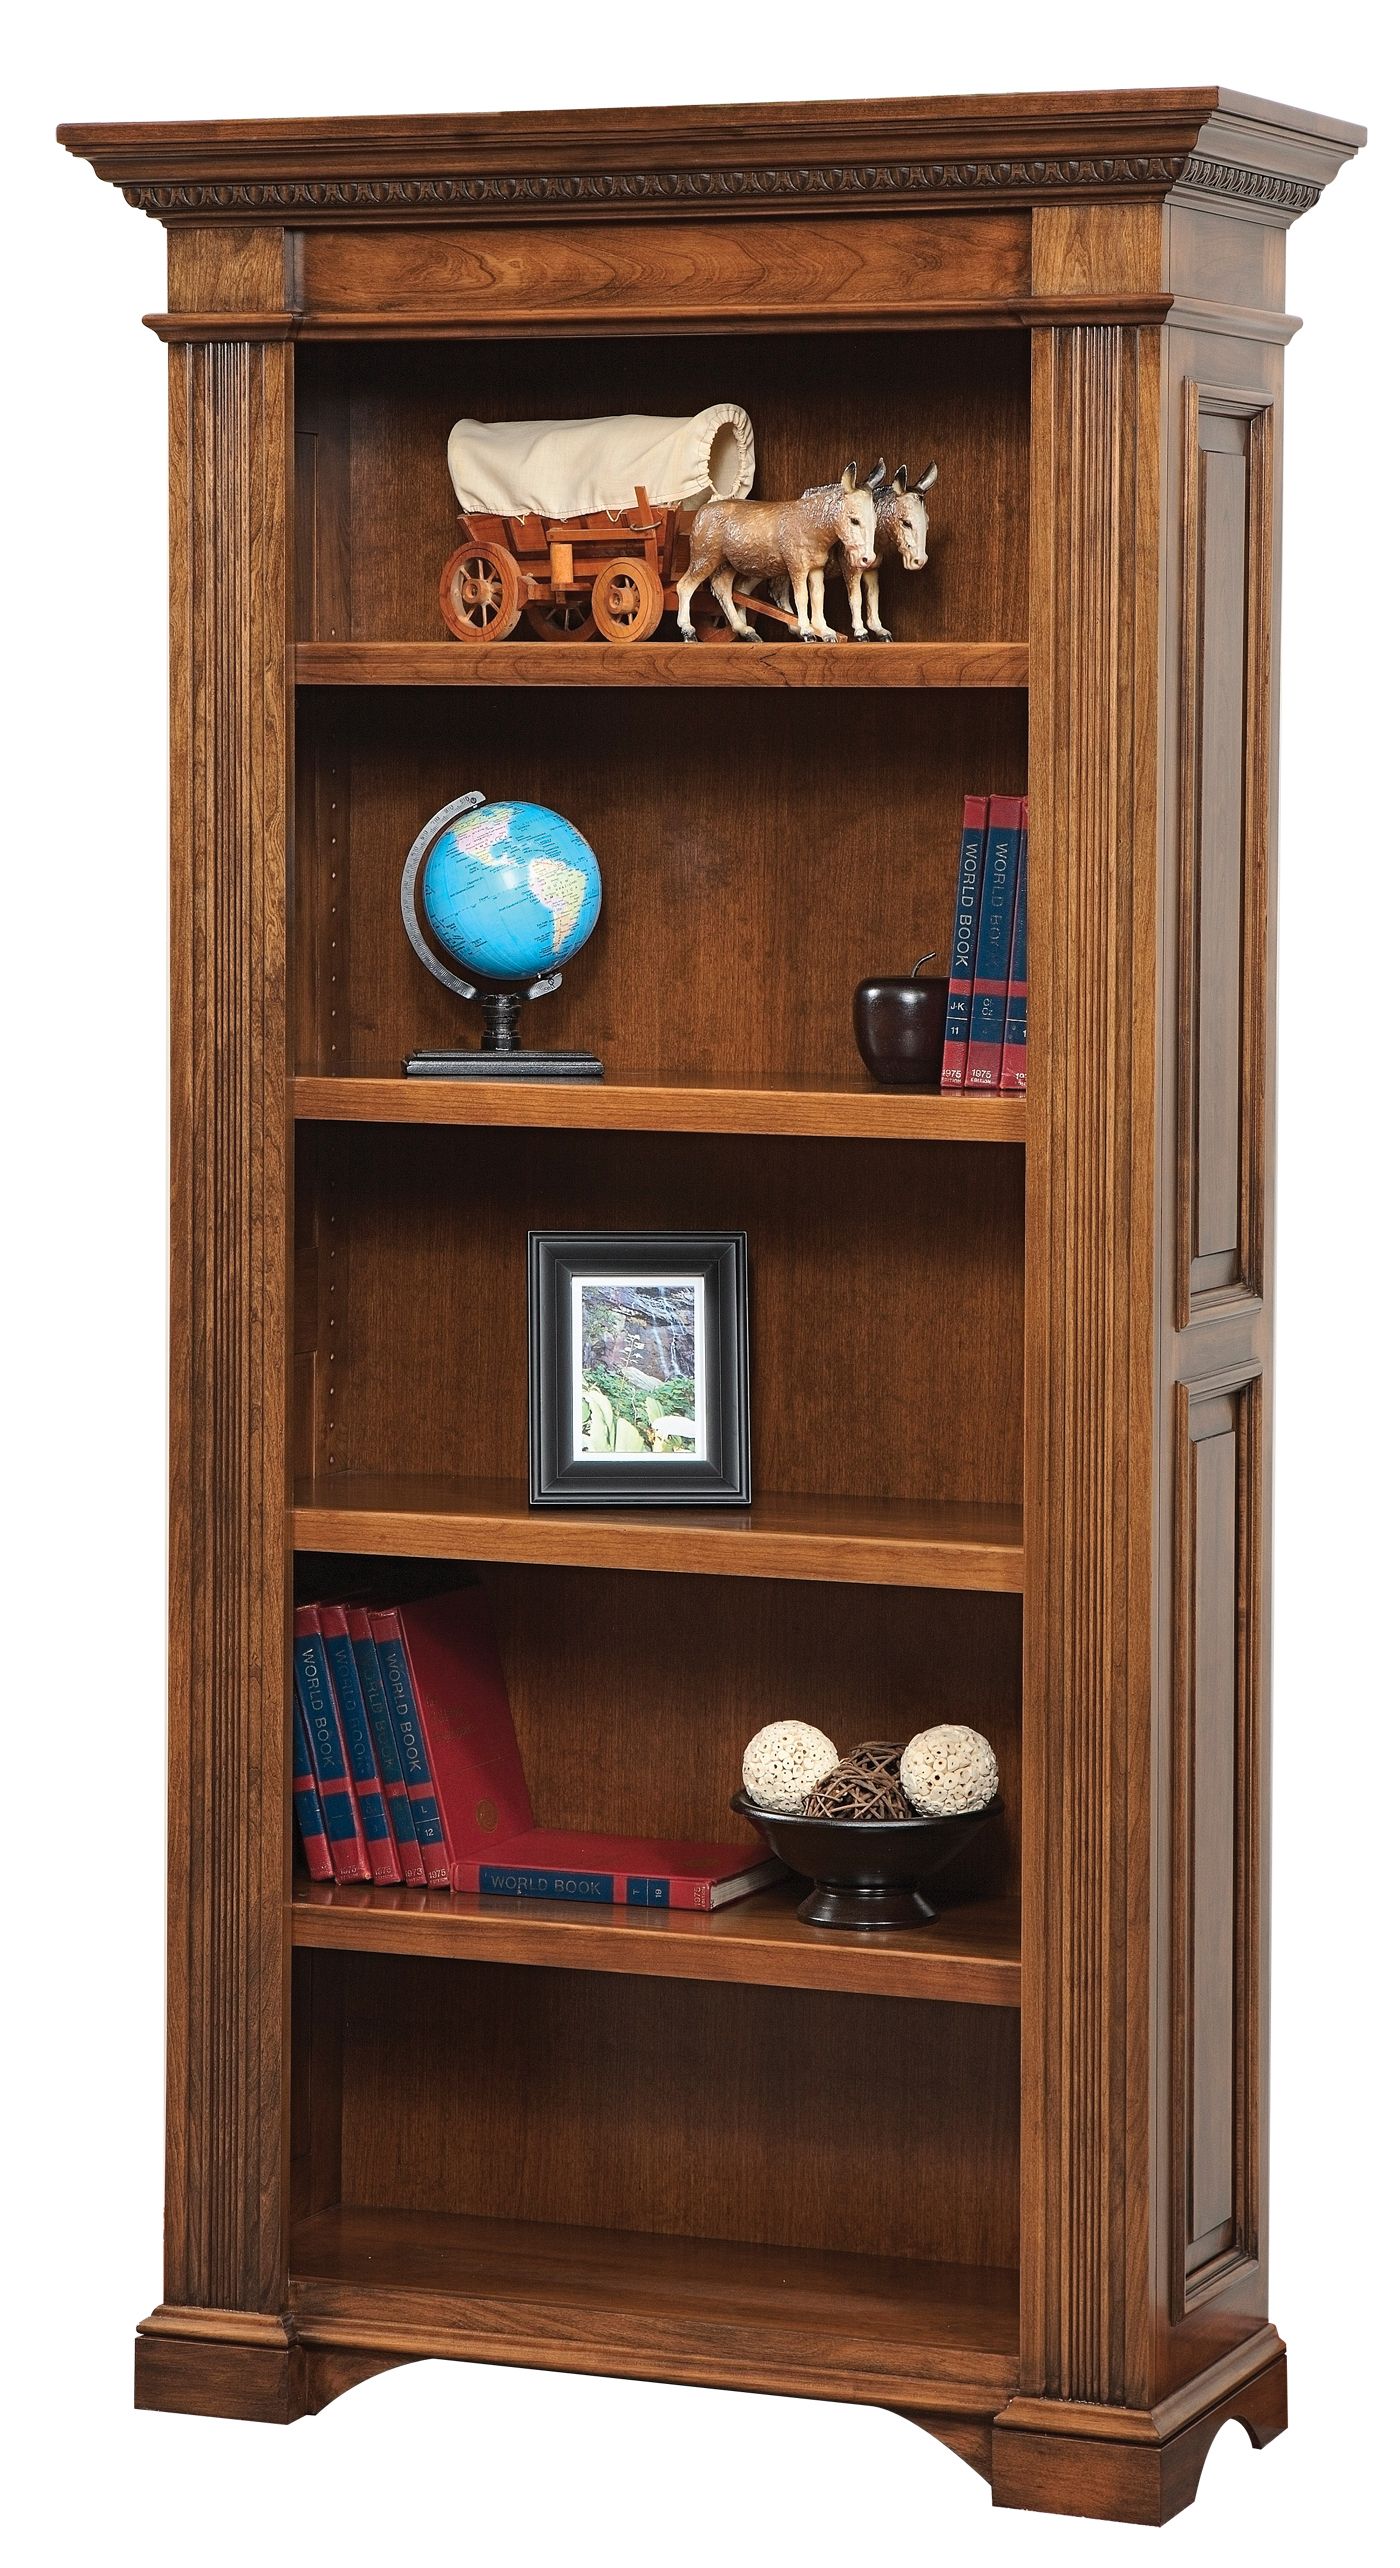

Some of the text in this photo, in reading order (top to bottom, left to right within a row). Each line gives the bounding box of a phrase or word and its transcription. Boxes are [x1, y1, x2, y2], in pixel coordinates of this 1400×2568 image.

[991, 843, 1008, 907] WORLD
[955, 843, 978, 967] WORLD BOOK
[950, 1026, 959, 1035] 11
[942, 1069, 962, 1079] 1975
[971, 1069, 992, 1079] 1975
[302, 1648, 335, 1768] WORLD BOOK
[386, 1653, 422, 1772] WORLD BOOK
[421, 1805, 428, 1814] L
[425, 1828, 434, 1837] 12
[428, 1868, 447, 1880] 1975
[491, 1874, 601, 1895] WORLD BOOK
